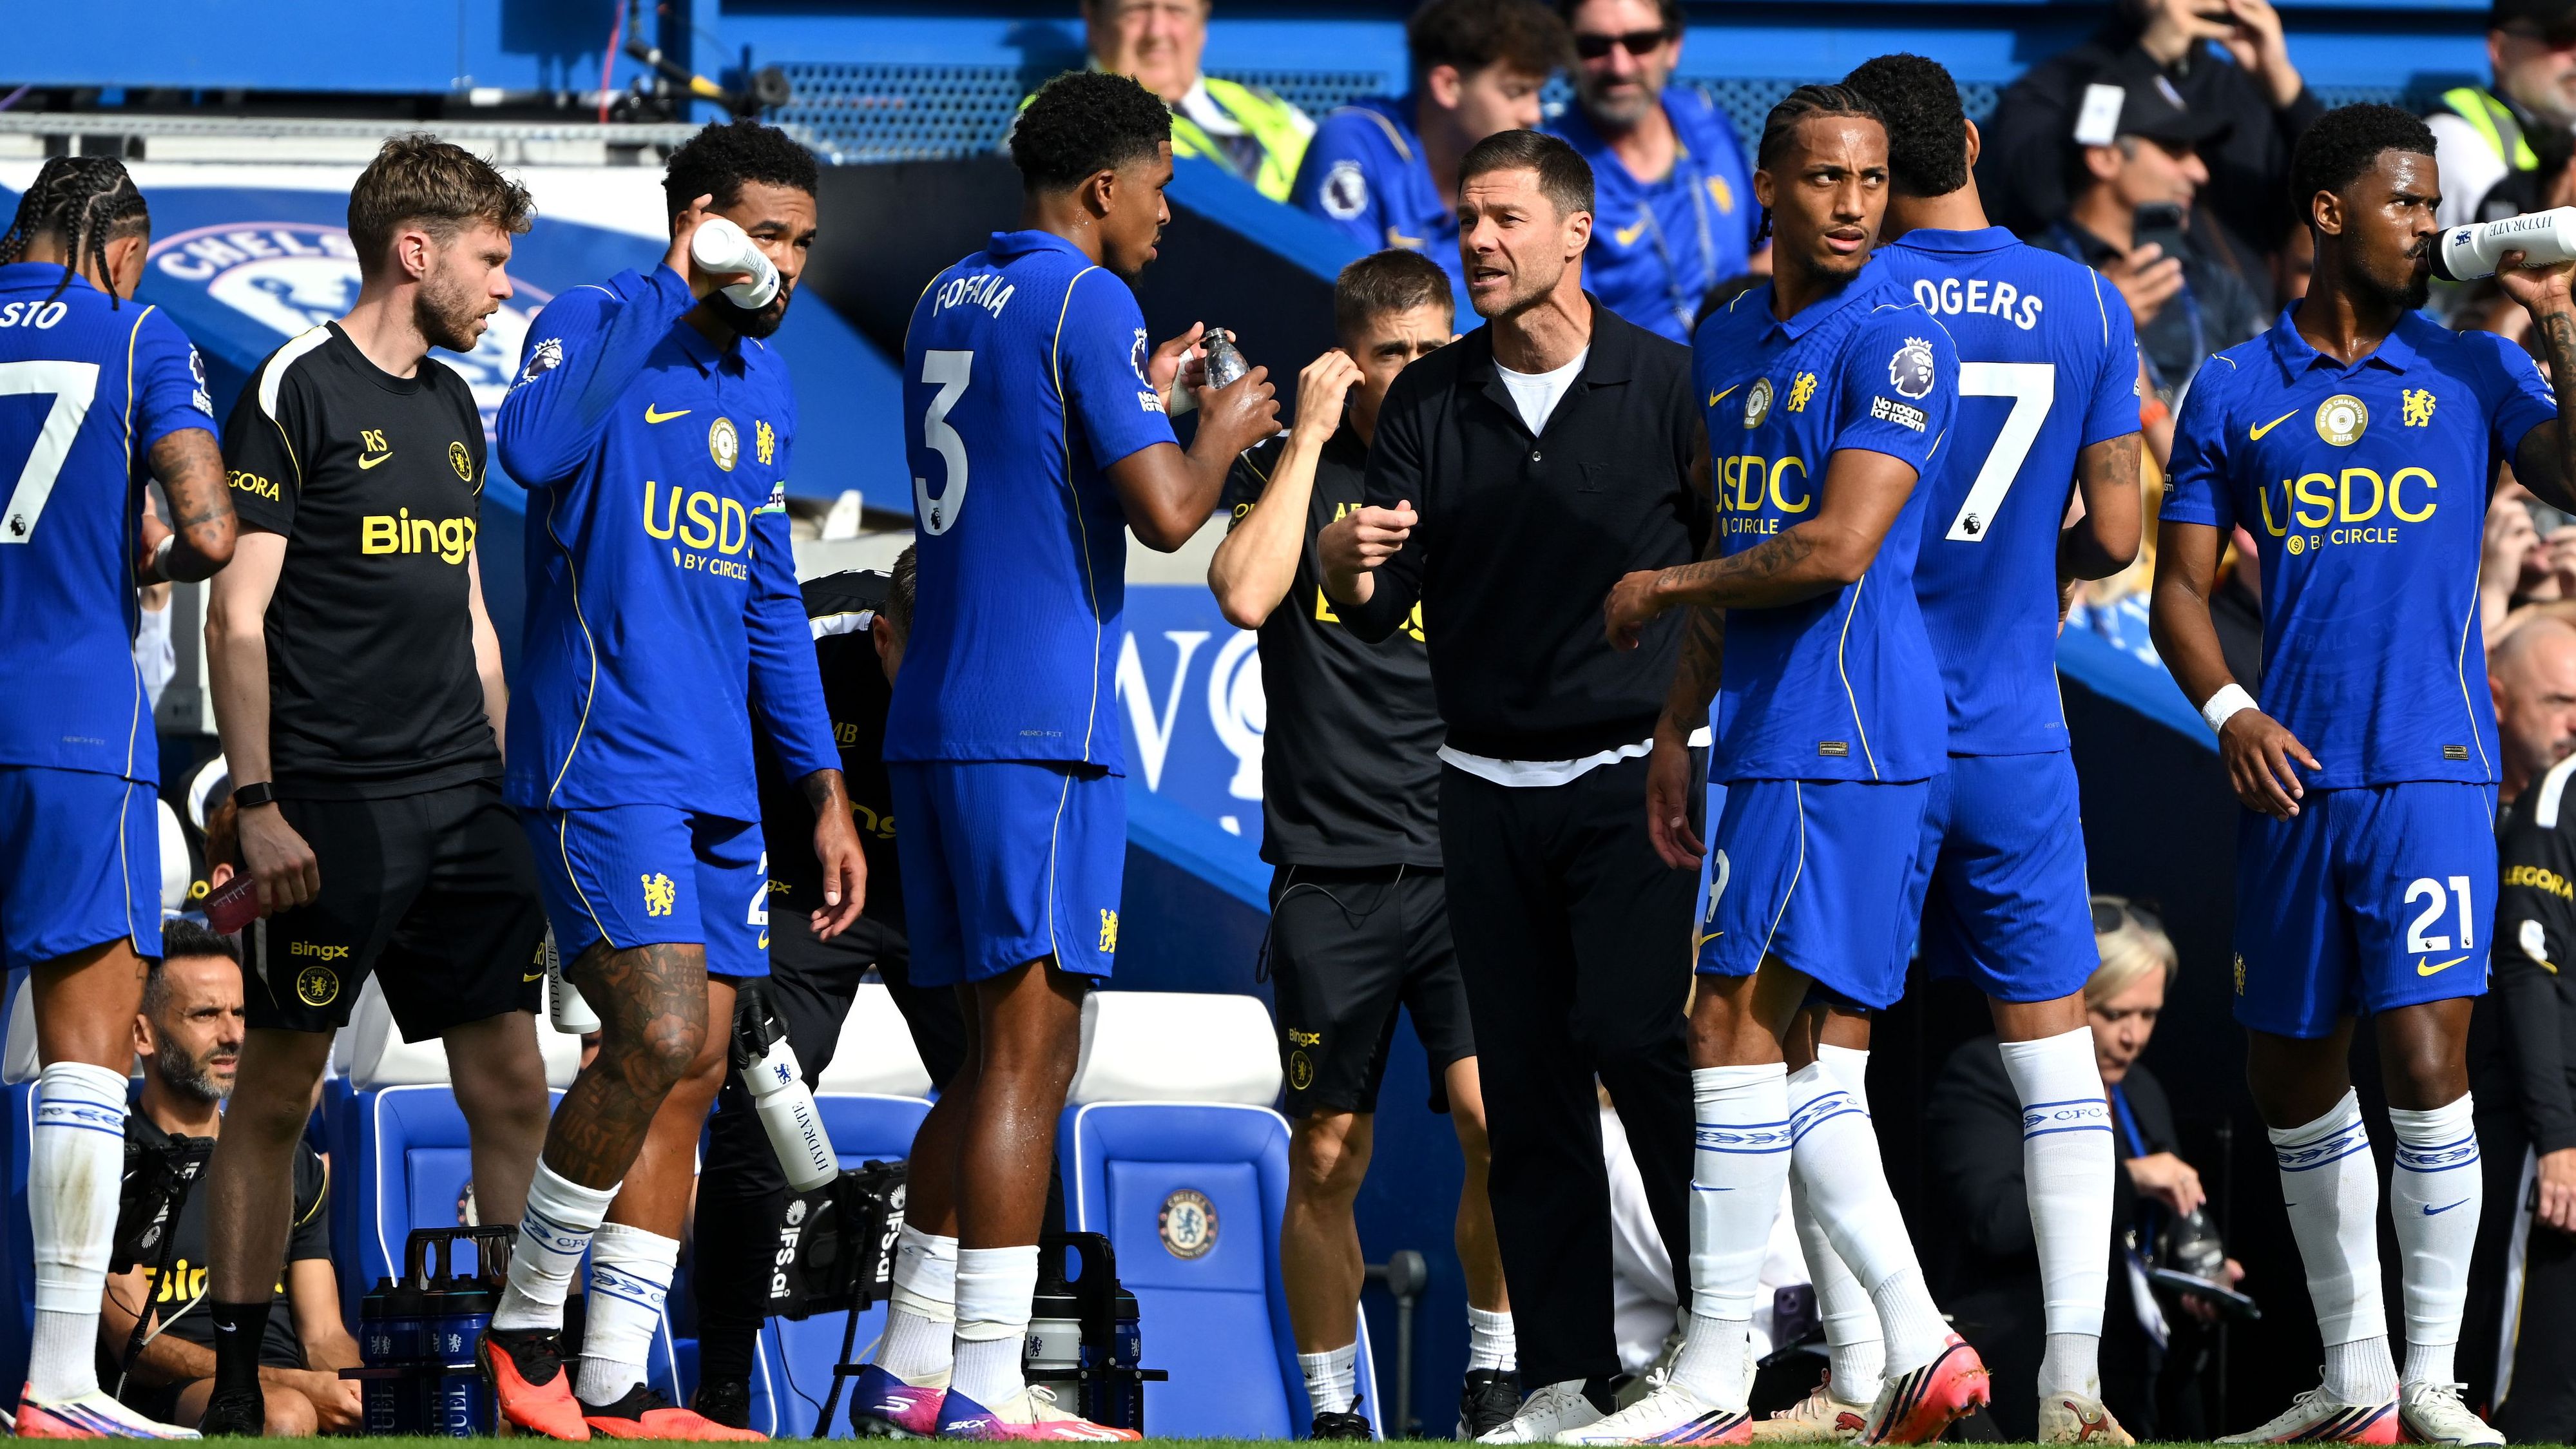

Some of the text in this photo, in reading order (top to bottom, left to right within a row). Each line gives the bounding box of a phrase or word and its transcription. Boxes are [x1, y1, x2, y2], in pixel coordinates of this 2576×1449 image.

[932, 274, 1015, 319] FOFANA
[1870, 406, 1889, 420] for
[1873, 396, 1923, 422] No room
[2320, 404, 2333, 428] WORLD
[2333, 399, 2363, 424] CHAMPIONS
[360, 429, 387, 452] RS
[915, 350, 974, 535] 3
[2332, 433, 2353, 443] FIFA
[2259, 466, 2438, 537] USDC
[2331, 528, 2398, 545] CIRCLE
[684, 553, 747, 581] BY CIRCLE
[2404, 876, 2474, 954] 21
[2054, 1108, 2102, 1120] CFC
[792, 1101, 829, 1171] HYDRATE
[945, 1418, 991, 1431] SKX
